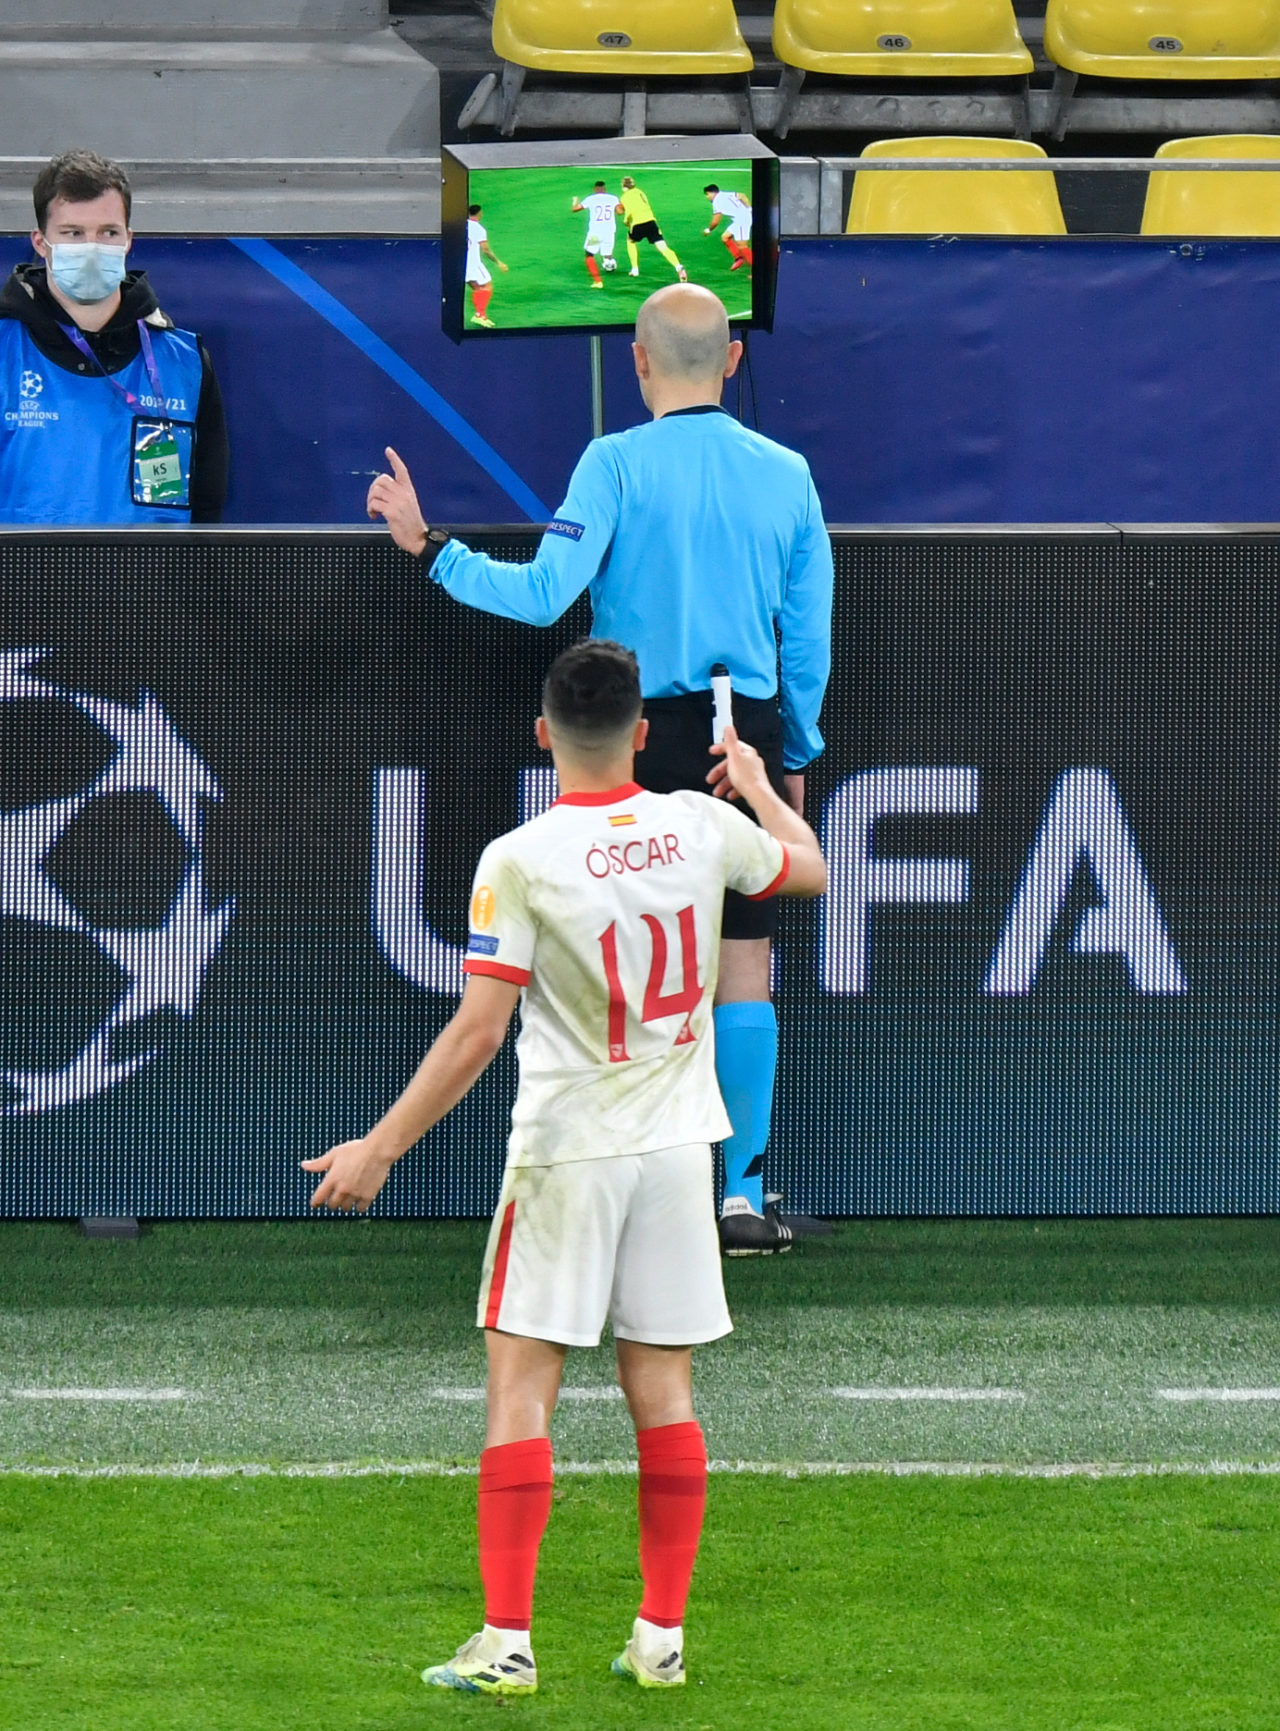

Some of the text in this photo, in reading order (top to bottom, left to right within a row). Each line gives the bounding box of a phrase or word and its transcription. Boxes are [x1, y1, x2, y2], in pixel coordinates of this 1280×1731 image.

[604, 36, 624, 46] 47
[884, 38, 904, 48] 46
[1155, 40, 1176, 50] 45
[594, 204, 613, 222] 25
[4, 411, 60, 421] CHMPIONS
[585, 833, 687, 879] ÓSCAR
[373, 767, 1189, 995] UFA
[598, 904, 705, 1063] 14
